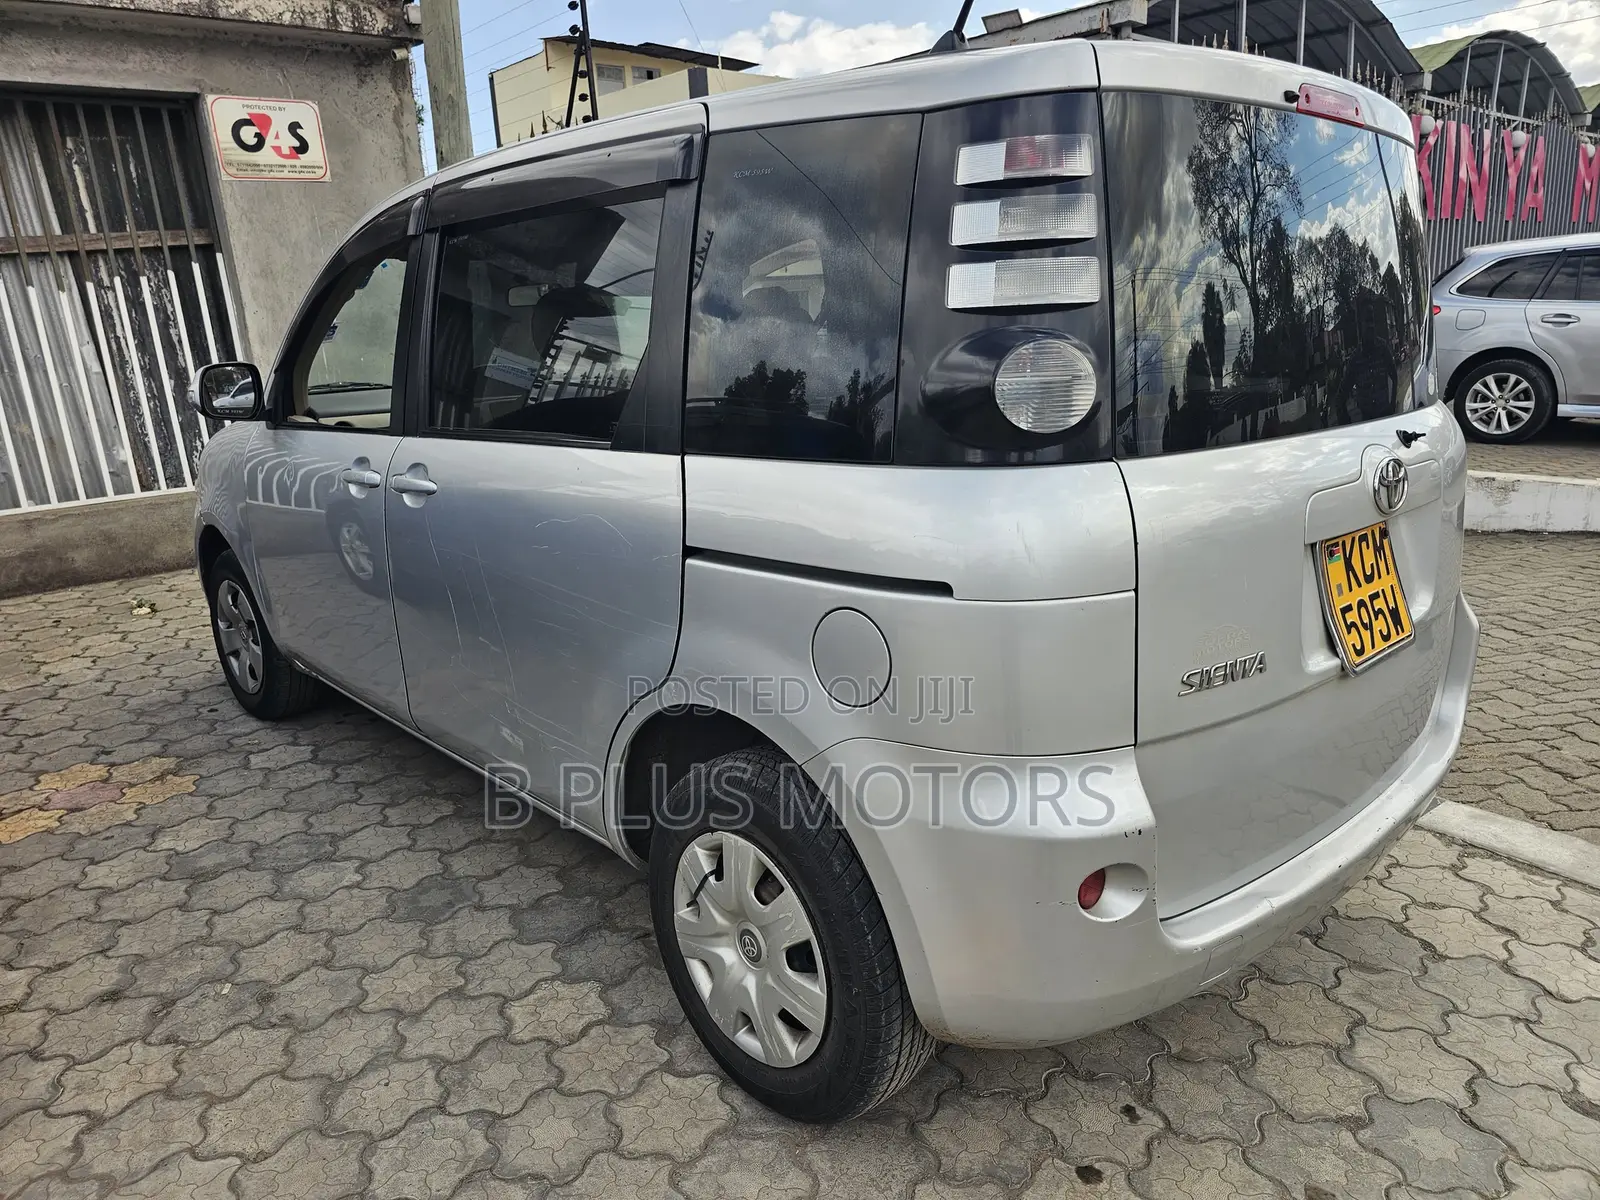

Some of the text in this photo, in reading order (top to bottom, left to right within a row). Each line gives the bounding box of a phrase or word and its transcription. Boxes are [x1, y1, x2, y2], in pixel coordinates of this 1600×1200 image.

[242, 103, 277, 112] PROTECTED
[231, 112, 310, 160] G4S
[1341, 526, 1390, 593] KCM
[1339, 584, 1405, 658] 595W
[1177, 650, 1267, 697] SIENTA
